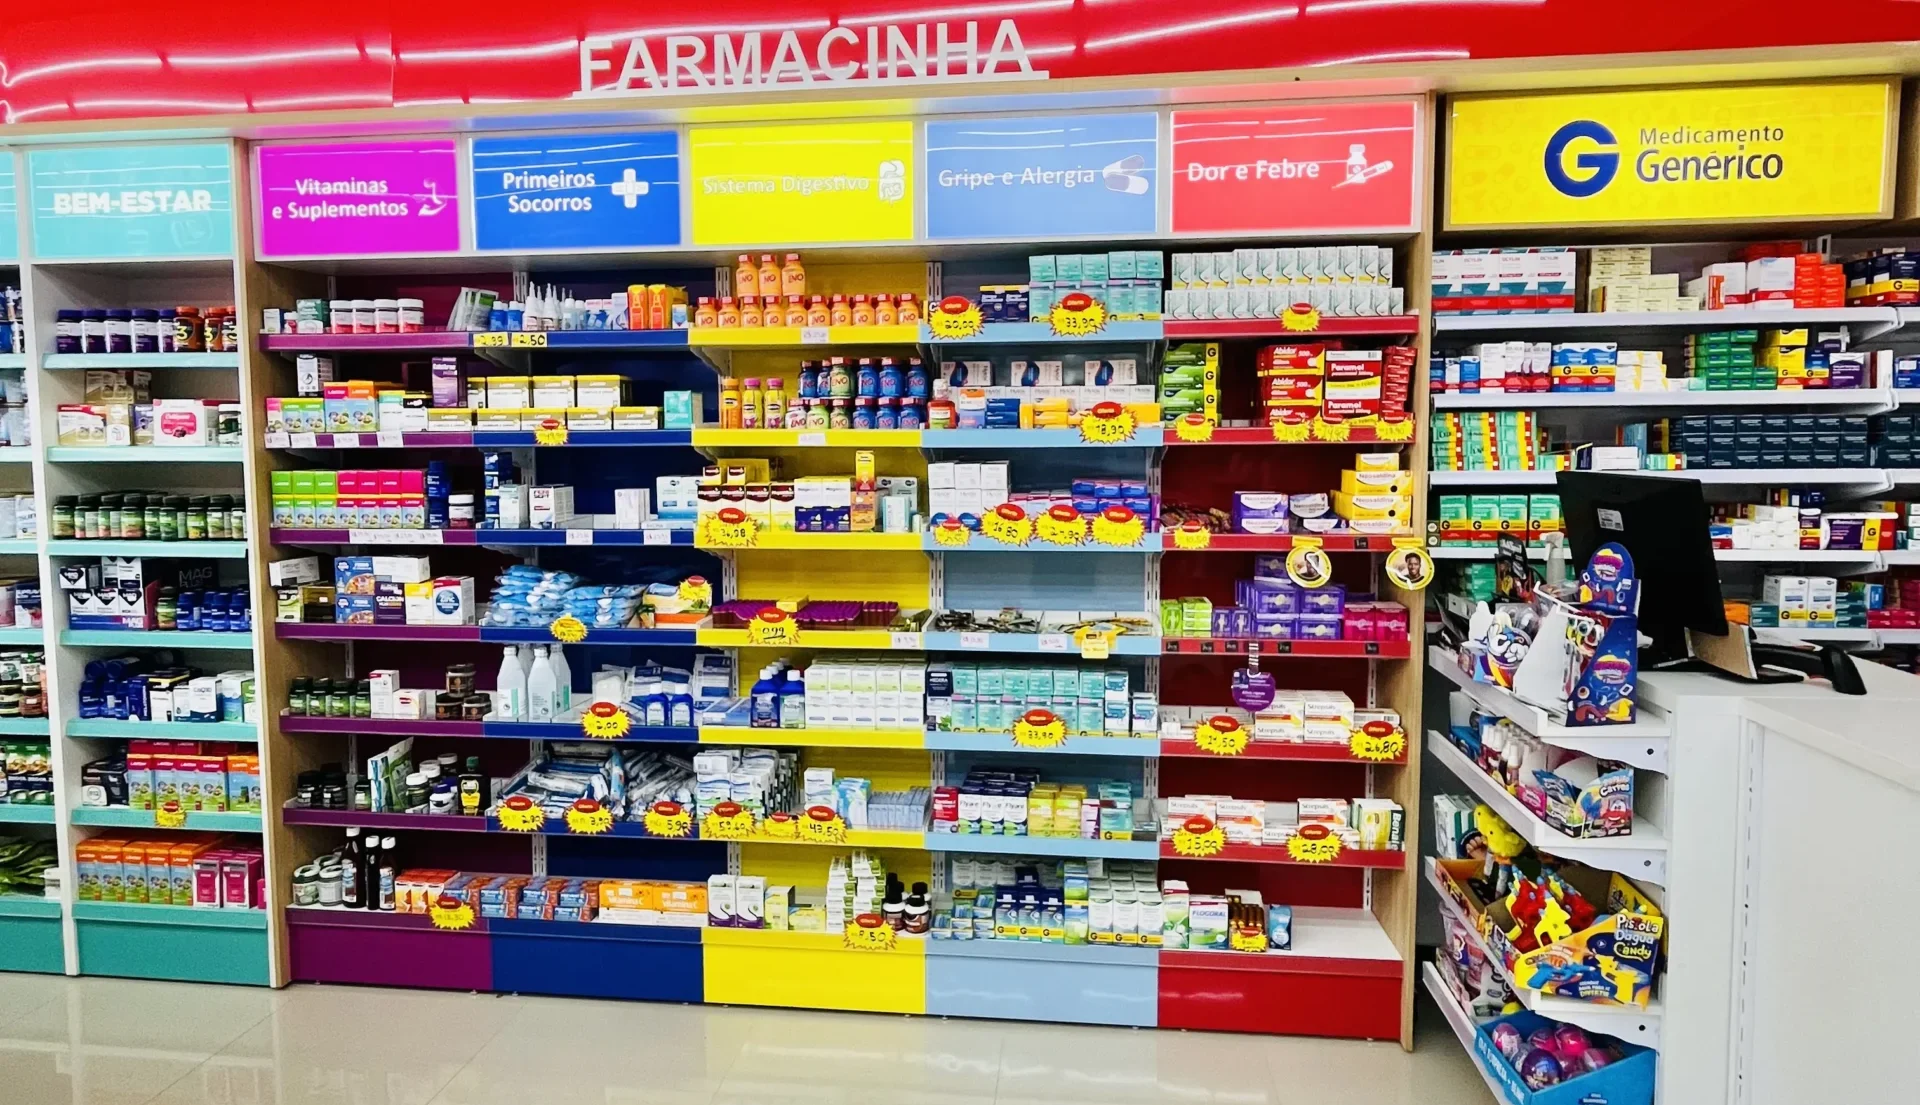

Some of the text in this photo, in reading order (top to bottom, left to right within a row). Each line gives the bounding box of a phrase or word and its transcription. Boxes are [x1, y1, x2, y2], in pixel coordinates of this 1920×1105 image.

[580, 19, 1034, 91] FARMACINHA
[1639, 125, 1784, 145] Medicamento
[1544, 119, 1620, 198] G
[1635, 145, 1784, 183] Genérico
[503, 170, 596, 190] Primeiros
[938, 165, 1095, 190] Gripe e Alergia
[1187, 159, 1319, 182] Dor e Febre
[295, 177, 388, 196] Vitaminas
[703, 175, 870, 196] Sistema Digestivo
[54, 190, 211, 215] BEM-ESTAR
[272, 200, 409, 222] e Suplementos
[508, 195, 593, 213] Socorros
[1893, 280, 1903, 290] G
[1207, 347, 1216, 358] G
[1205, 370, 1214, 380] G
[1563, 366, 1572, 375] G
[1206, 394, 1215, 404] G
[1391, 812, 1402, 850] Benale
